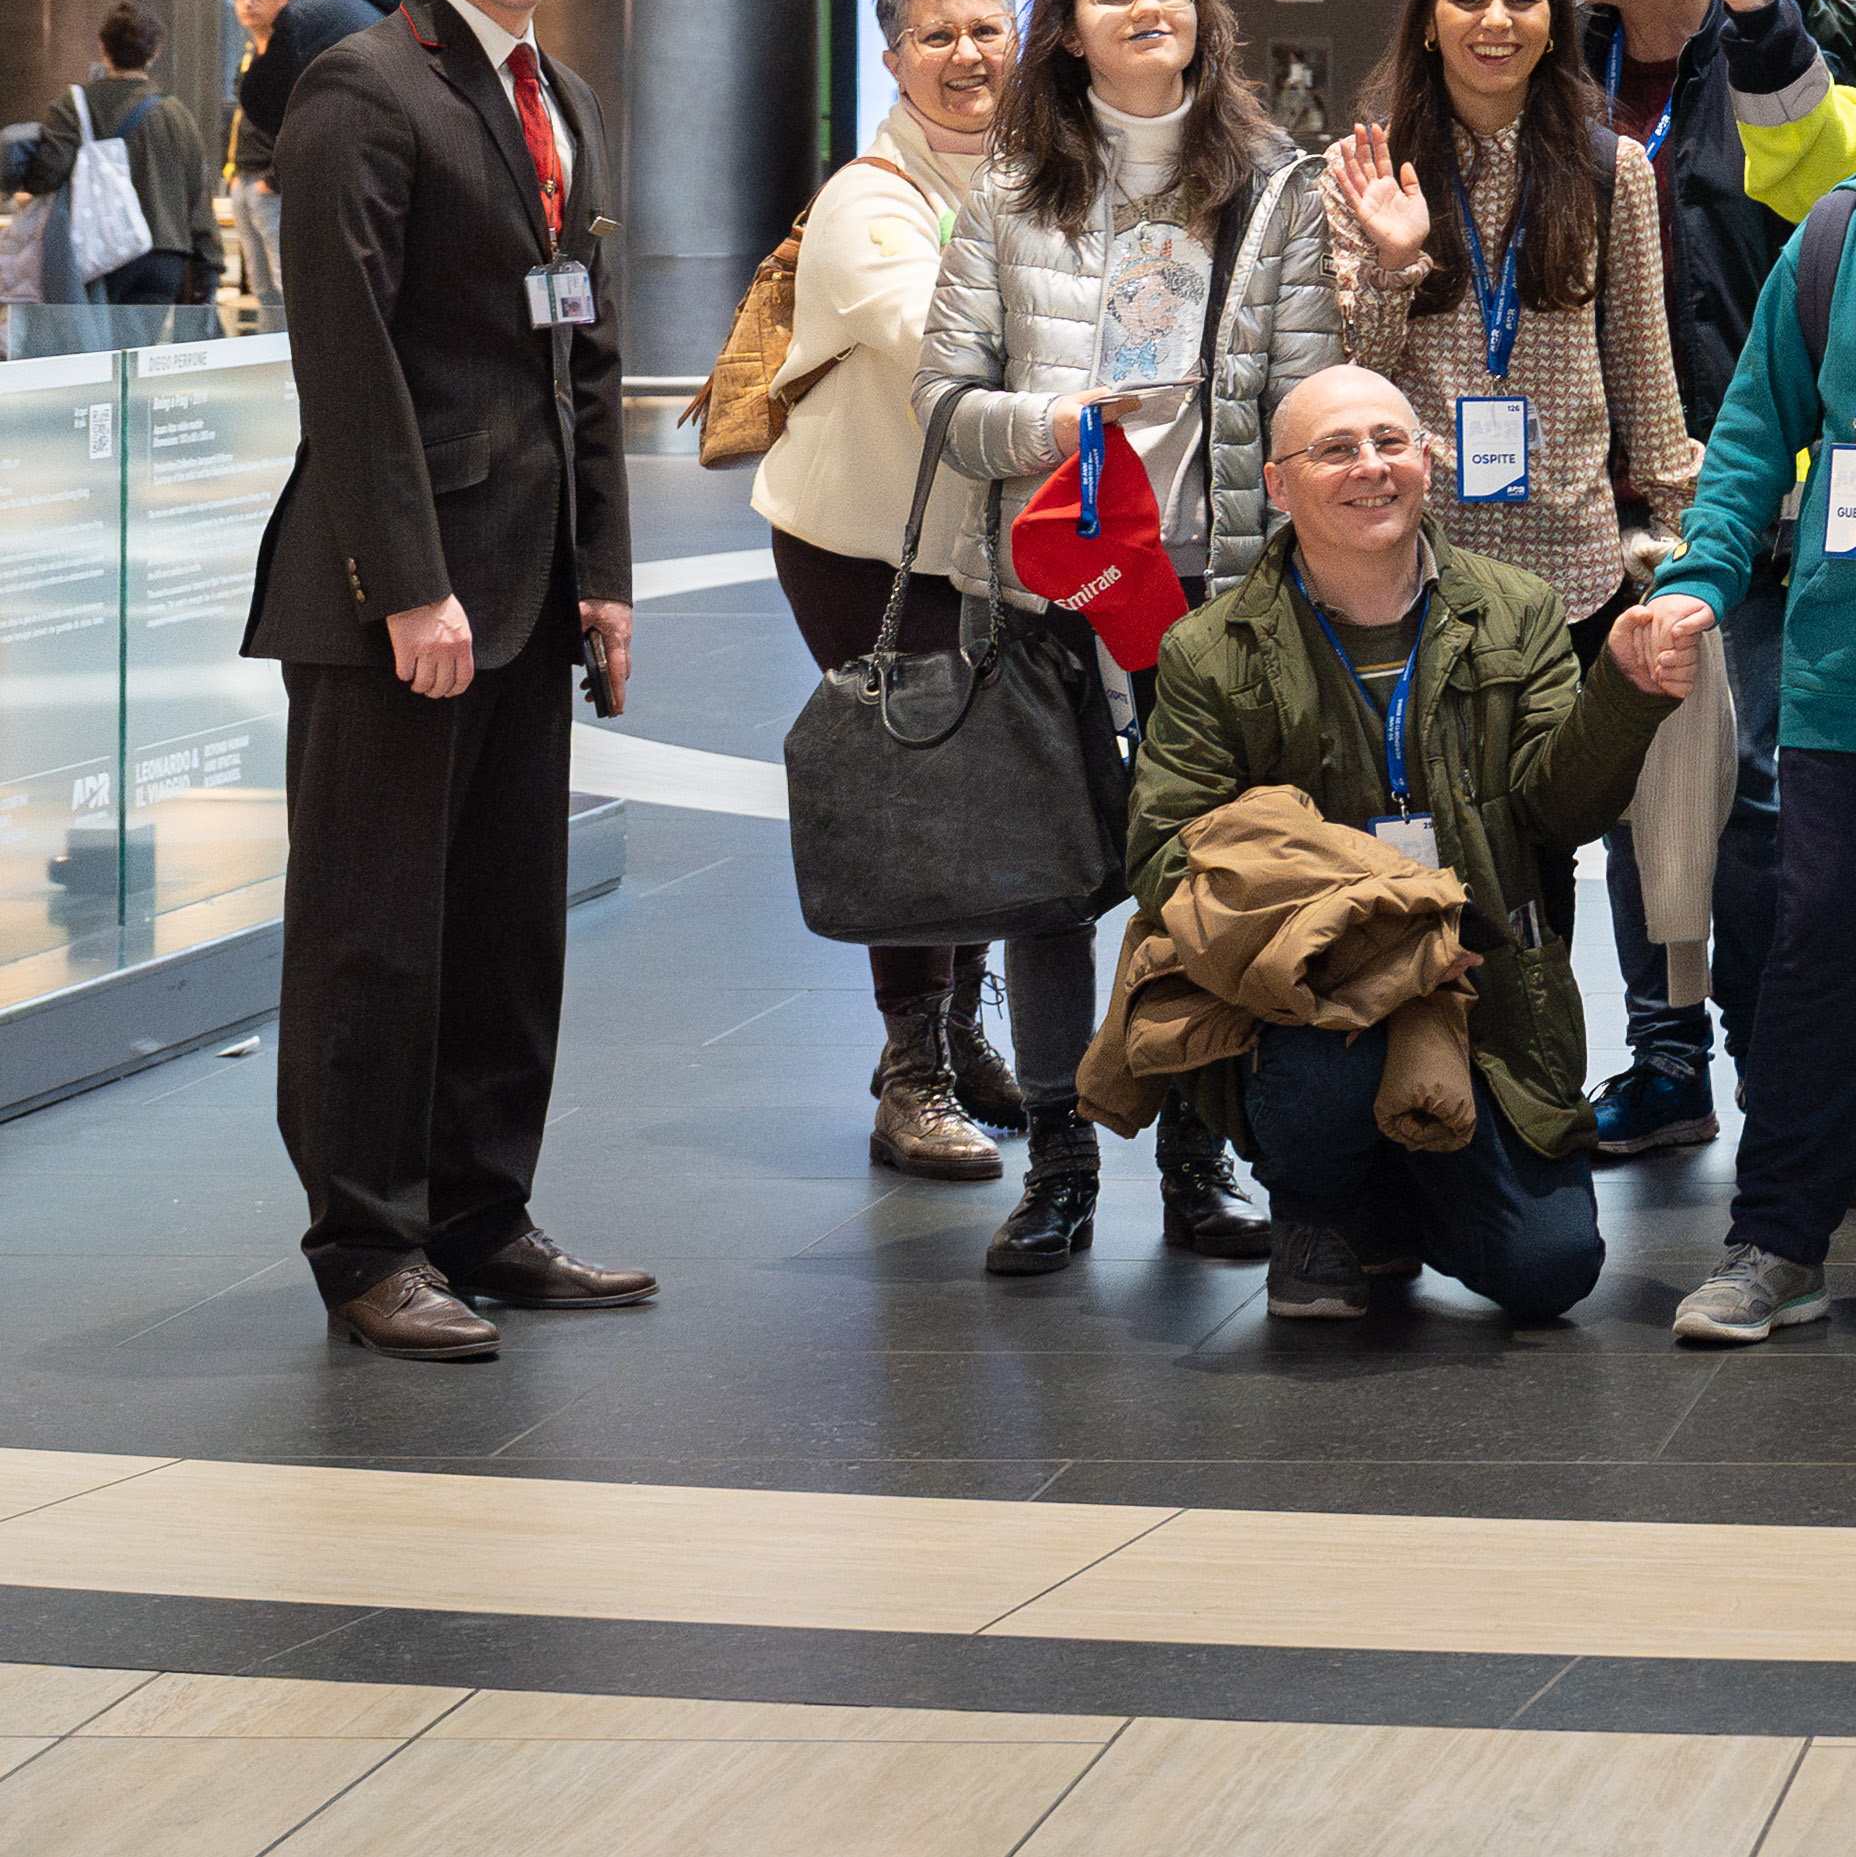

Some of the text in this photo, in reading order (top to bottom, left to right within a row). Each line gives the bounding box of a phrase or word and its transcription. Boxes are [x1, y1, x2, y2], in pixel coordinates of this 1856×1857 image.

[1471, 453, 1517, 465] OSPITE
[135, 750, 190, 784] LEONARDO
[71, 771, 110, 811] ADR
